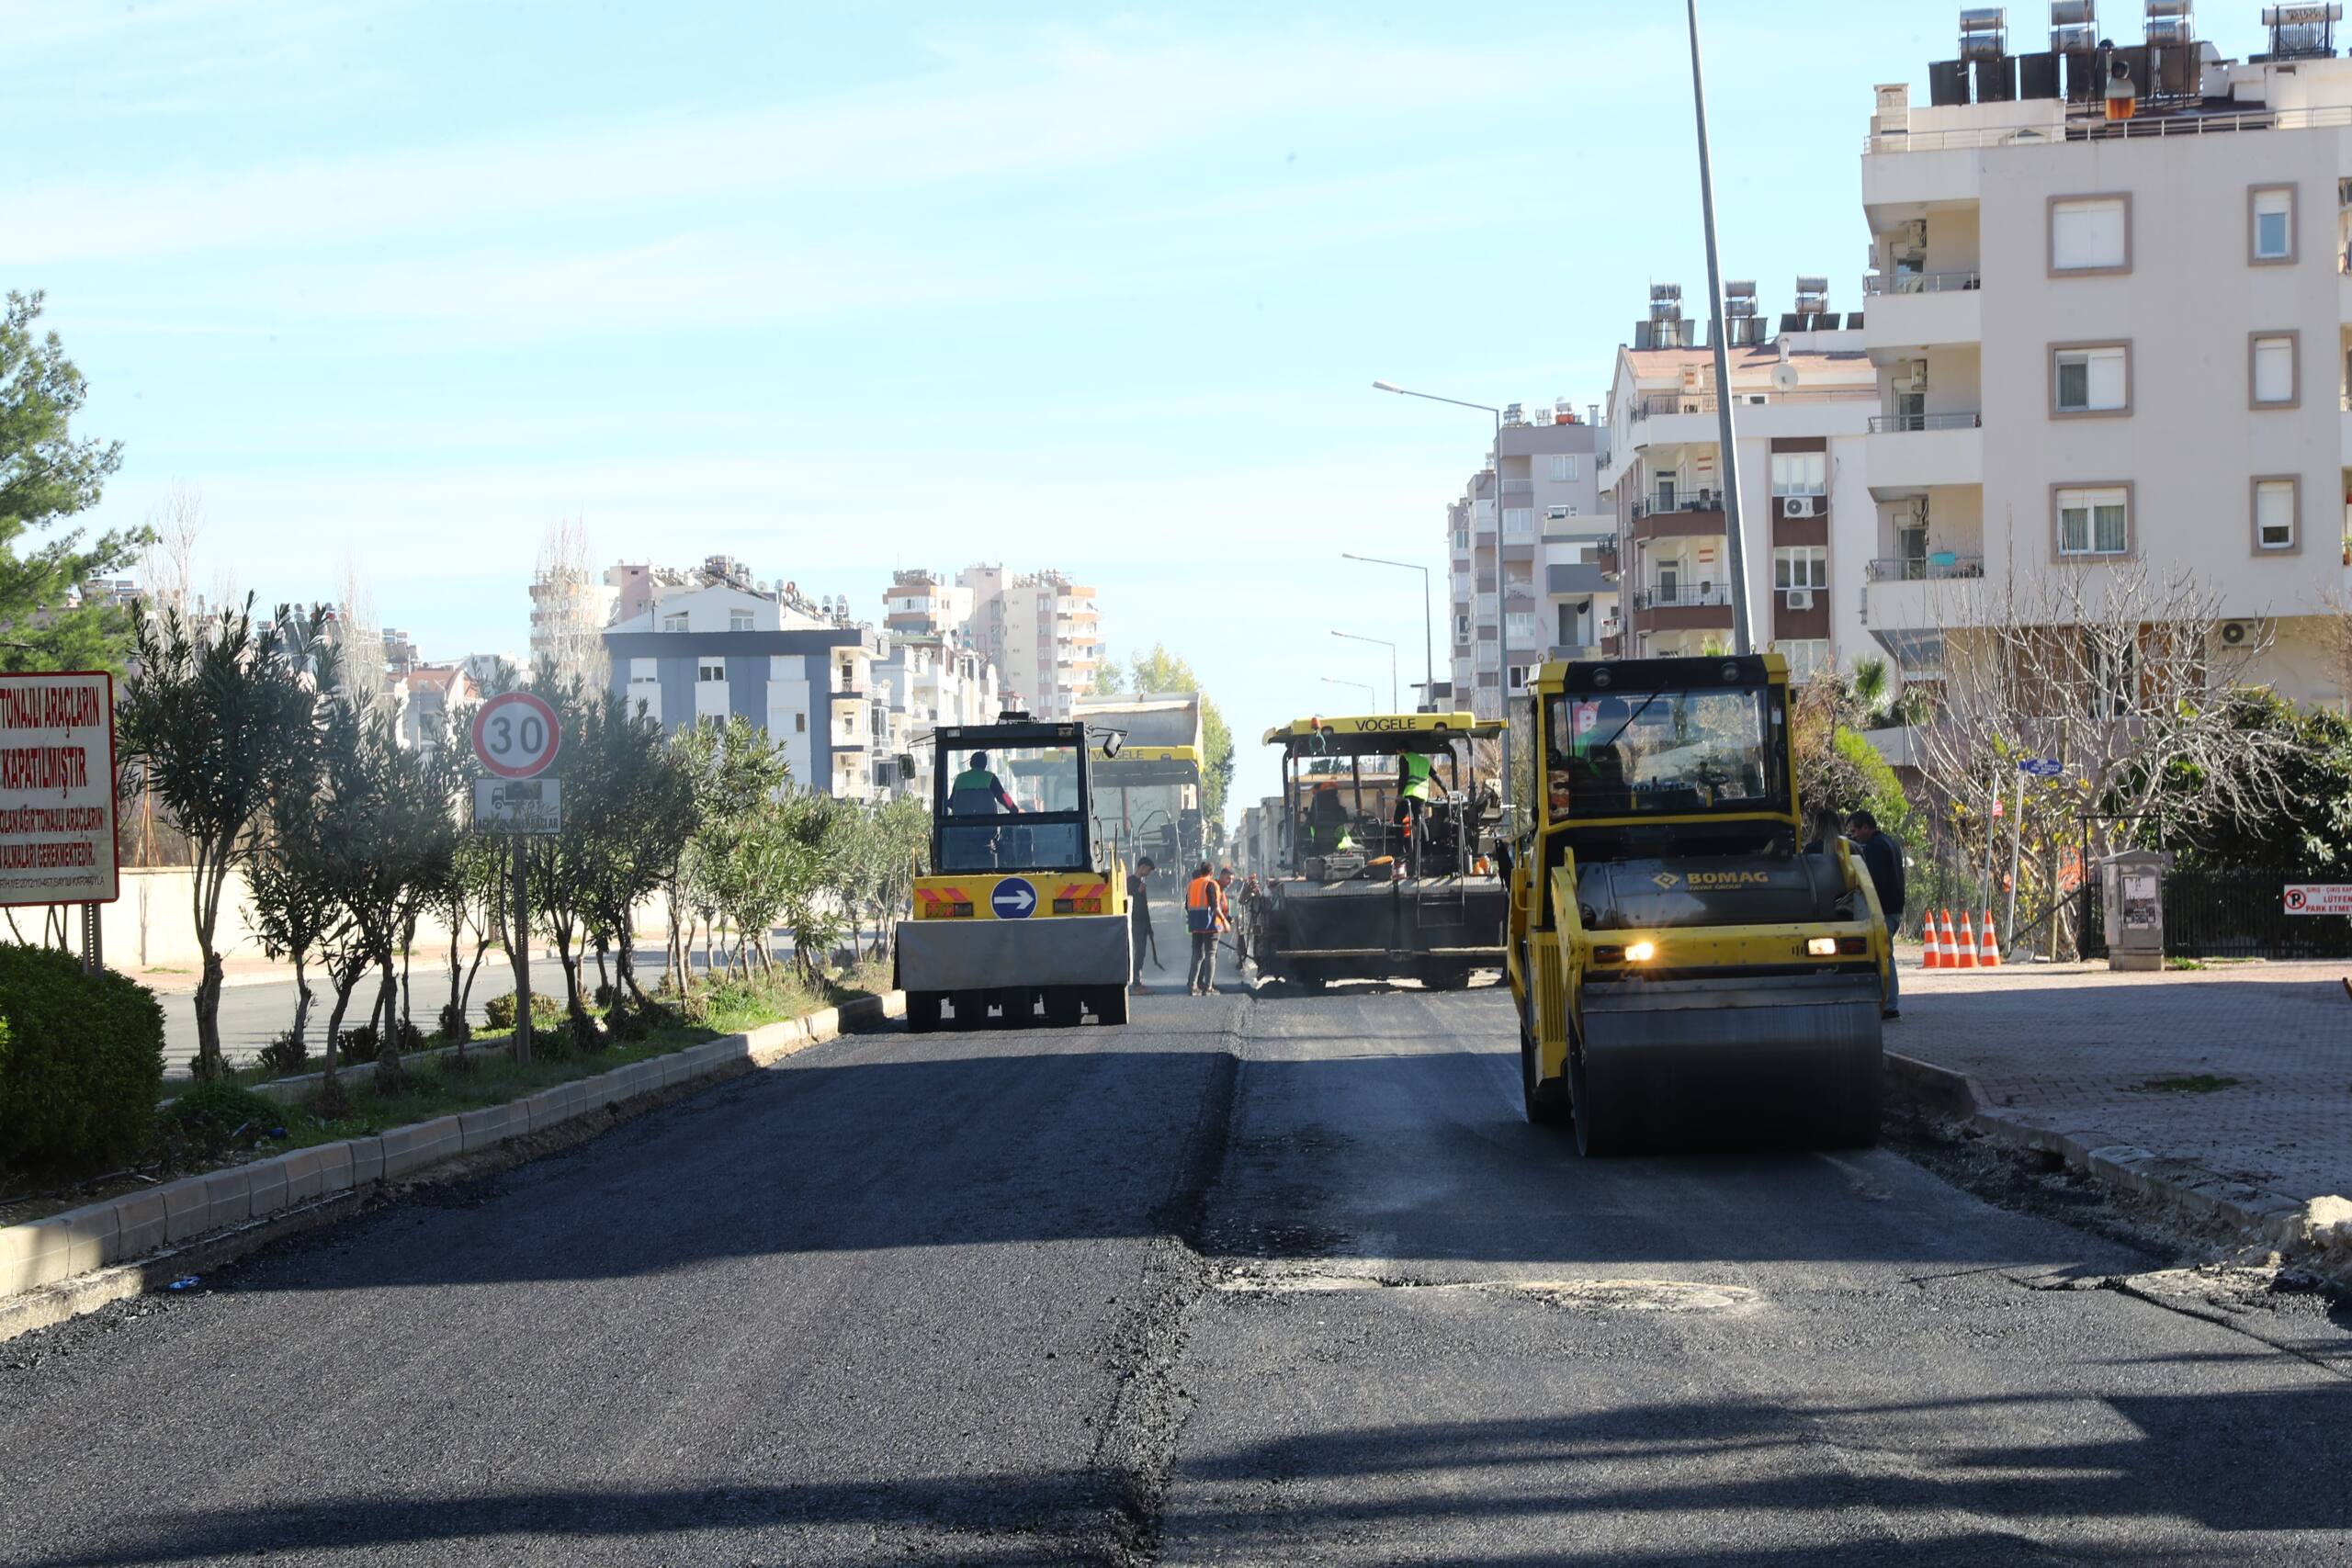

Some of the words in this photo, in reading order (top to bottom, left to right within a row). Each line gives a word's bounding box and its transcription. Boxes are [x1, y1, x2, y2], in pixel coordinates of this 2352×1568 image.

[0, 687, 41, 728] TONAJLI
[45, 686, 99, 738] ARAÇLARIN
[491, 716, 543, 754] 30
[3, 747, 87, 799] KAPATILMIŞTIR
[36, 808, 64, 832] TONAJLI
[66, 807, 103, 838] ARAÇLARIN
[4, 843, 37, 869] ALMALARI
[1687, 872, 1769, 884] BOMAG
